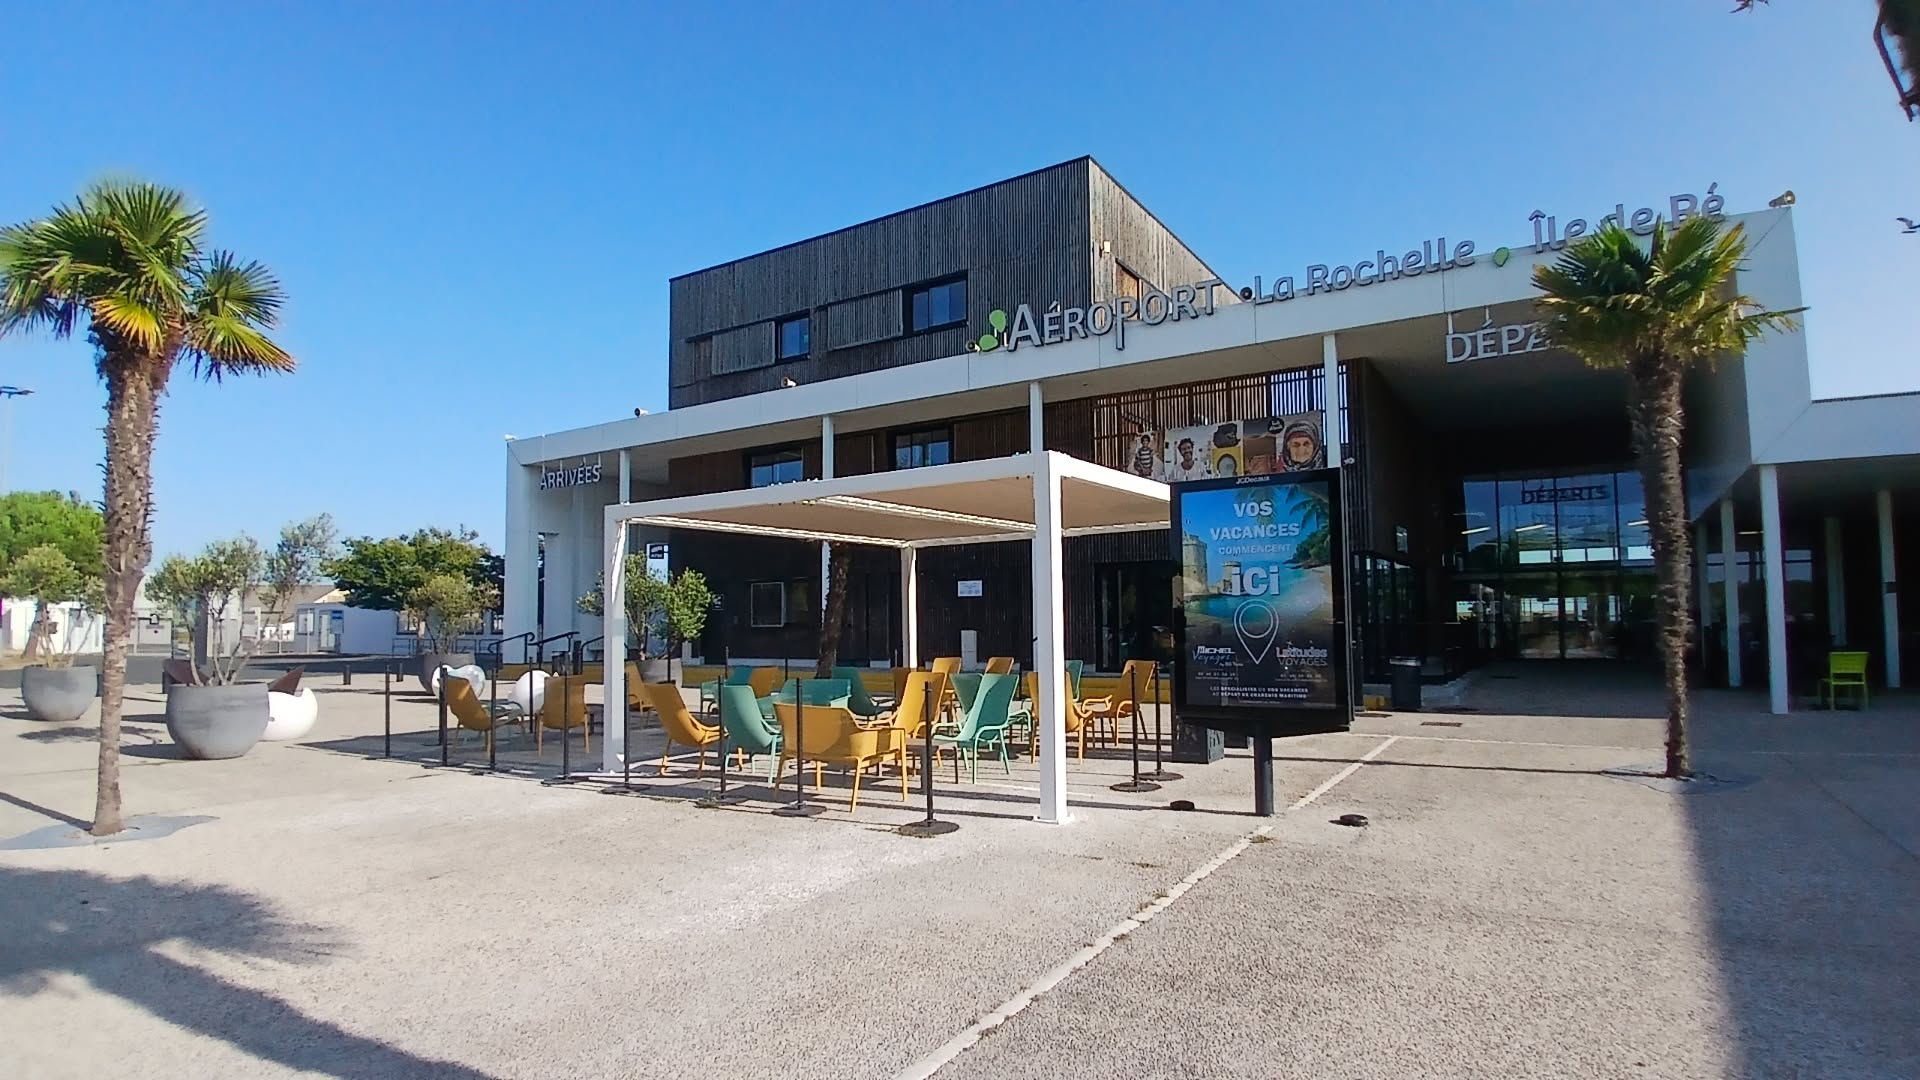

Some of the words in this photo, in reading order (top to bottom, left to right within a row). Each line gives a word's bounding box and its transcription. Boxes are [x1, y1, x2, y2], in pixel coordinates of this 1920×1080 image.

[1007, 278, 1222, 351] AÉROPORT
[1254, 275, 1295, 306] La
[1306, 237, 1476, 296] Rochelle
[1445, 318, 1554, 364] DÉPA
[540, 462, 601, 490] ARRIVÉES
[1236, 476, 1270, 485] JCDecaux
[1233, 500, 1273, 518] VOS
[1209, 523, 1300, 541] VACANCES
[1218, 543, 1292, 556] COMMENCENT
[1278, 657, 1328, 666] VOYAGES
